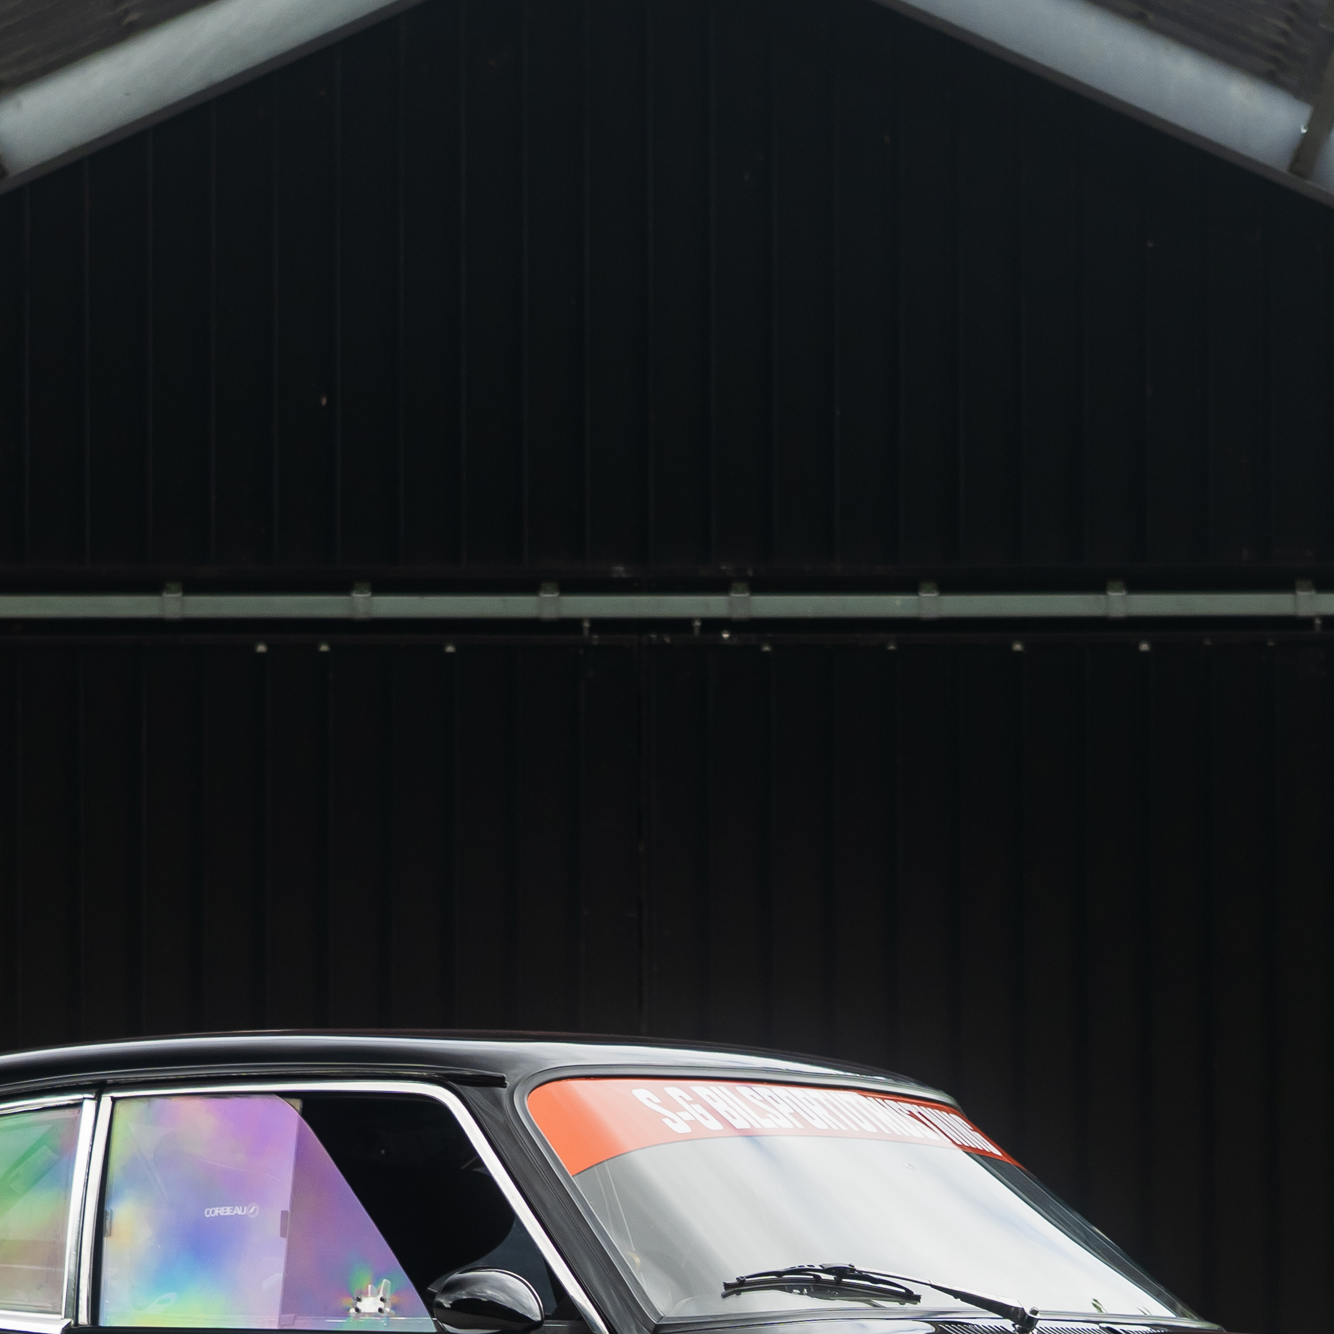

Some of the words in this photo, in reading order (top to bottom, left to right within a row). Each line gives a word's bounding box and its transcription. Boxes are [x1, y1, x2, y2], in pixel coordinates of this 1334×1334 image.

[631, 1086, 724, 1134] S-G
[690, 1086, 1003, 1157] BILSPORTUTRUSTNING
[204, 1205, 247, 1218] CORBEAU
